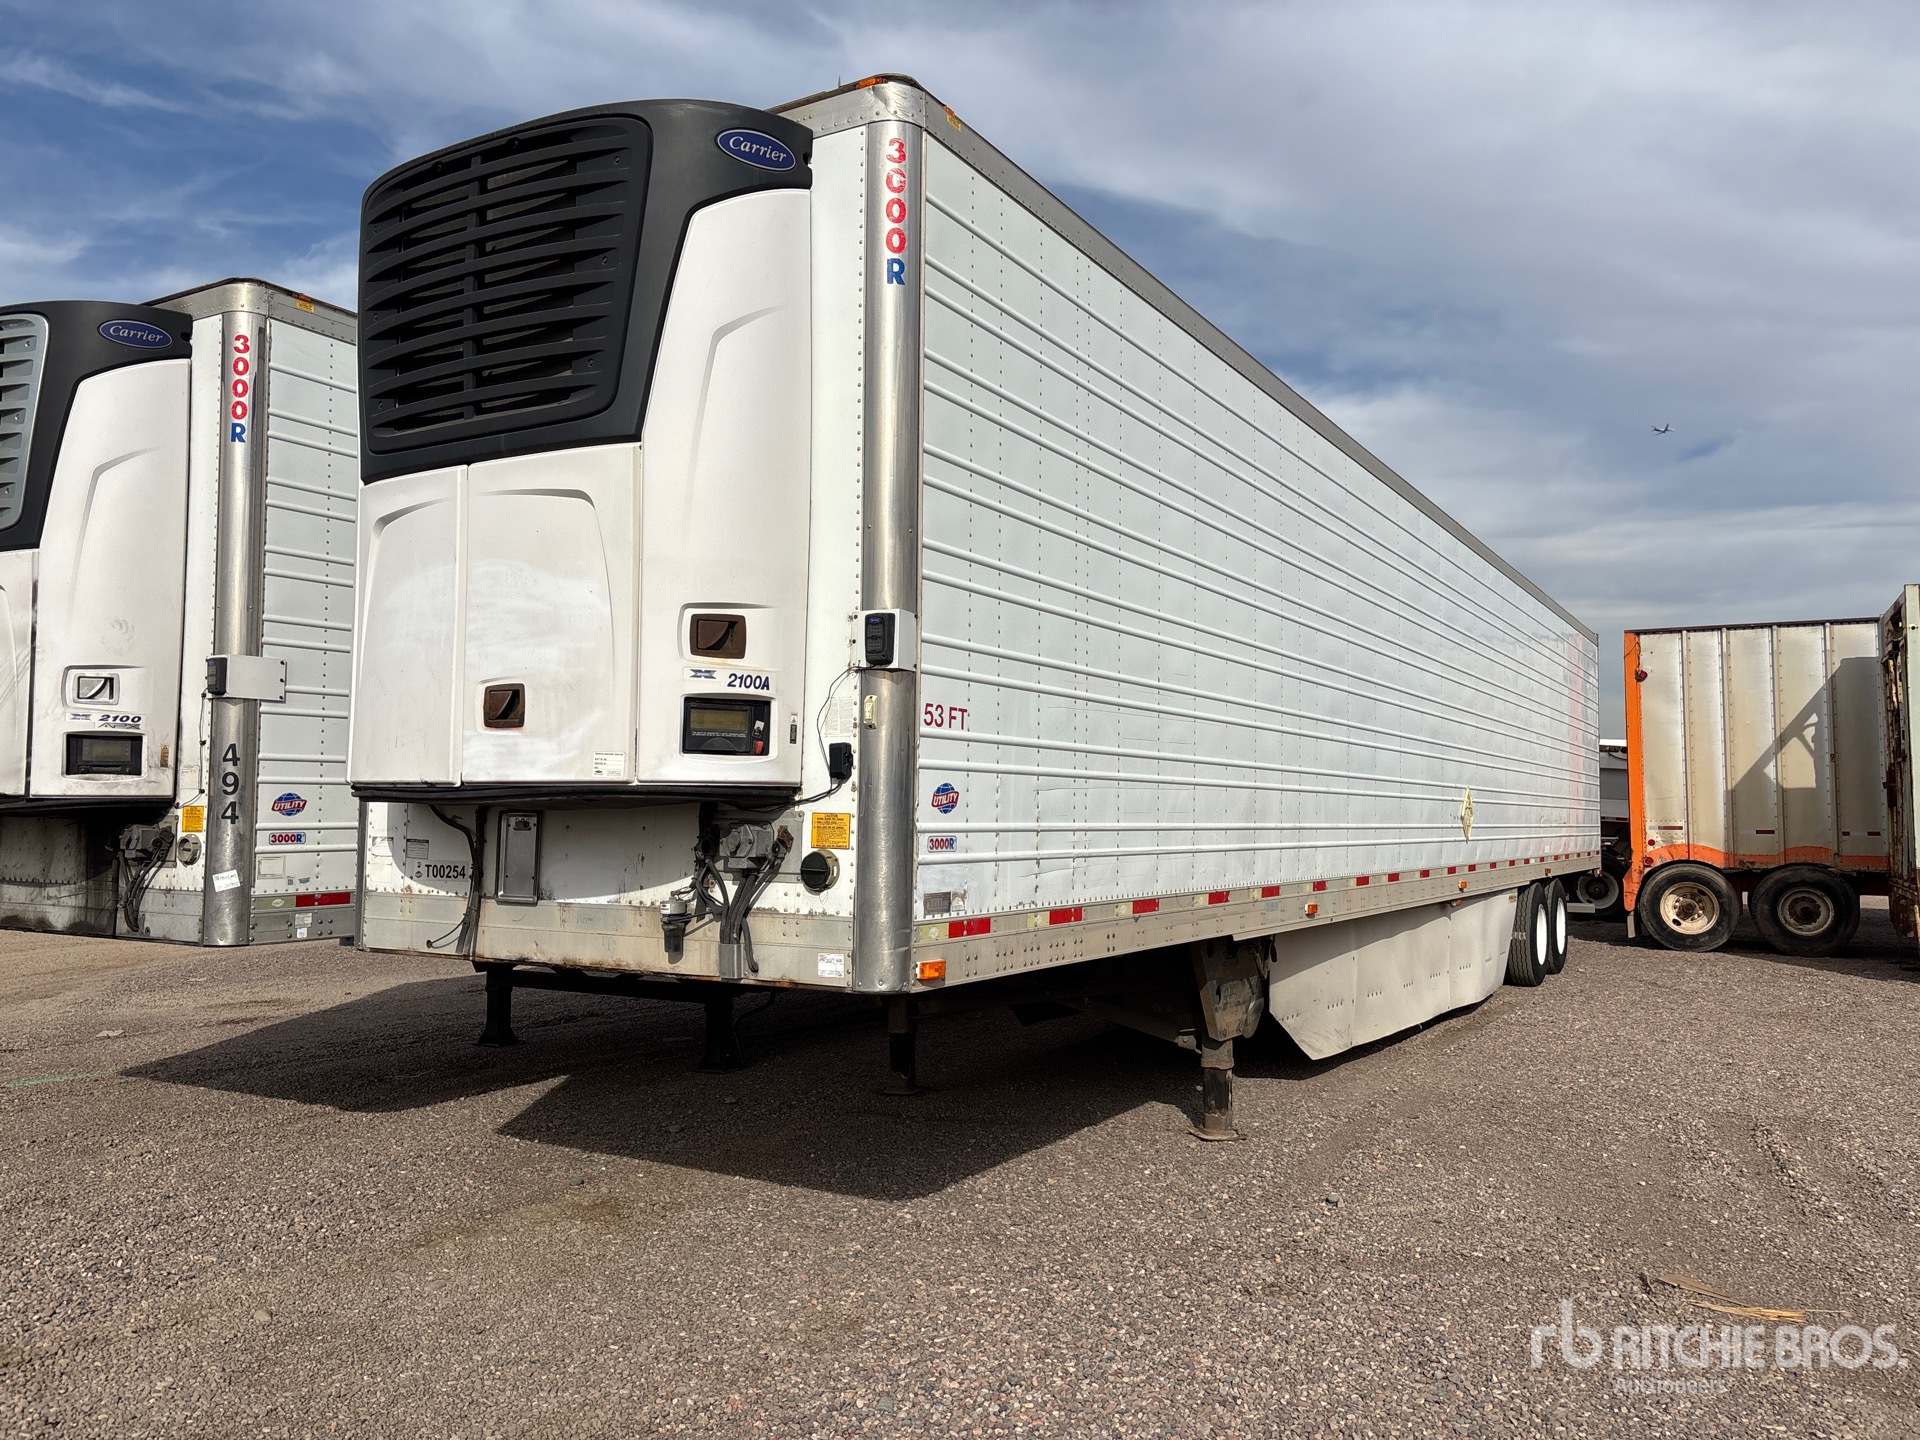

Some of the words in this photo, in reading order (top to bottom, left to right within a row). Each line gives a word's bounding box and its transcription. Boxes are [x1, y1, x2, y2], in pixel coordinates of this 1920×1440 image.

[728, 135, 787, 163] Carrier
[109, 324, 164, 344] Carrier
[230, 334, 251, 443] 3000R
[727, 673, 770, 691] 2100A
[98, 714, 142, 723] 2100
[924, 703, 944, 728] 53
[949, 706, 968, 730] FT
[220, 743, 241, 825] 494
[273, 799, 306, 811] UTILITY
[932, 792, 959, 807] UTILITY
[270, 833, 303, 843] 3000R
[929, 837, 955, 850] 3000R
[425, 864, 466, 879] T00254
